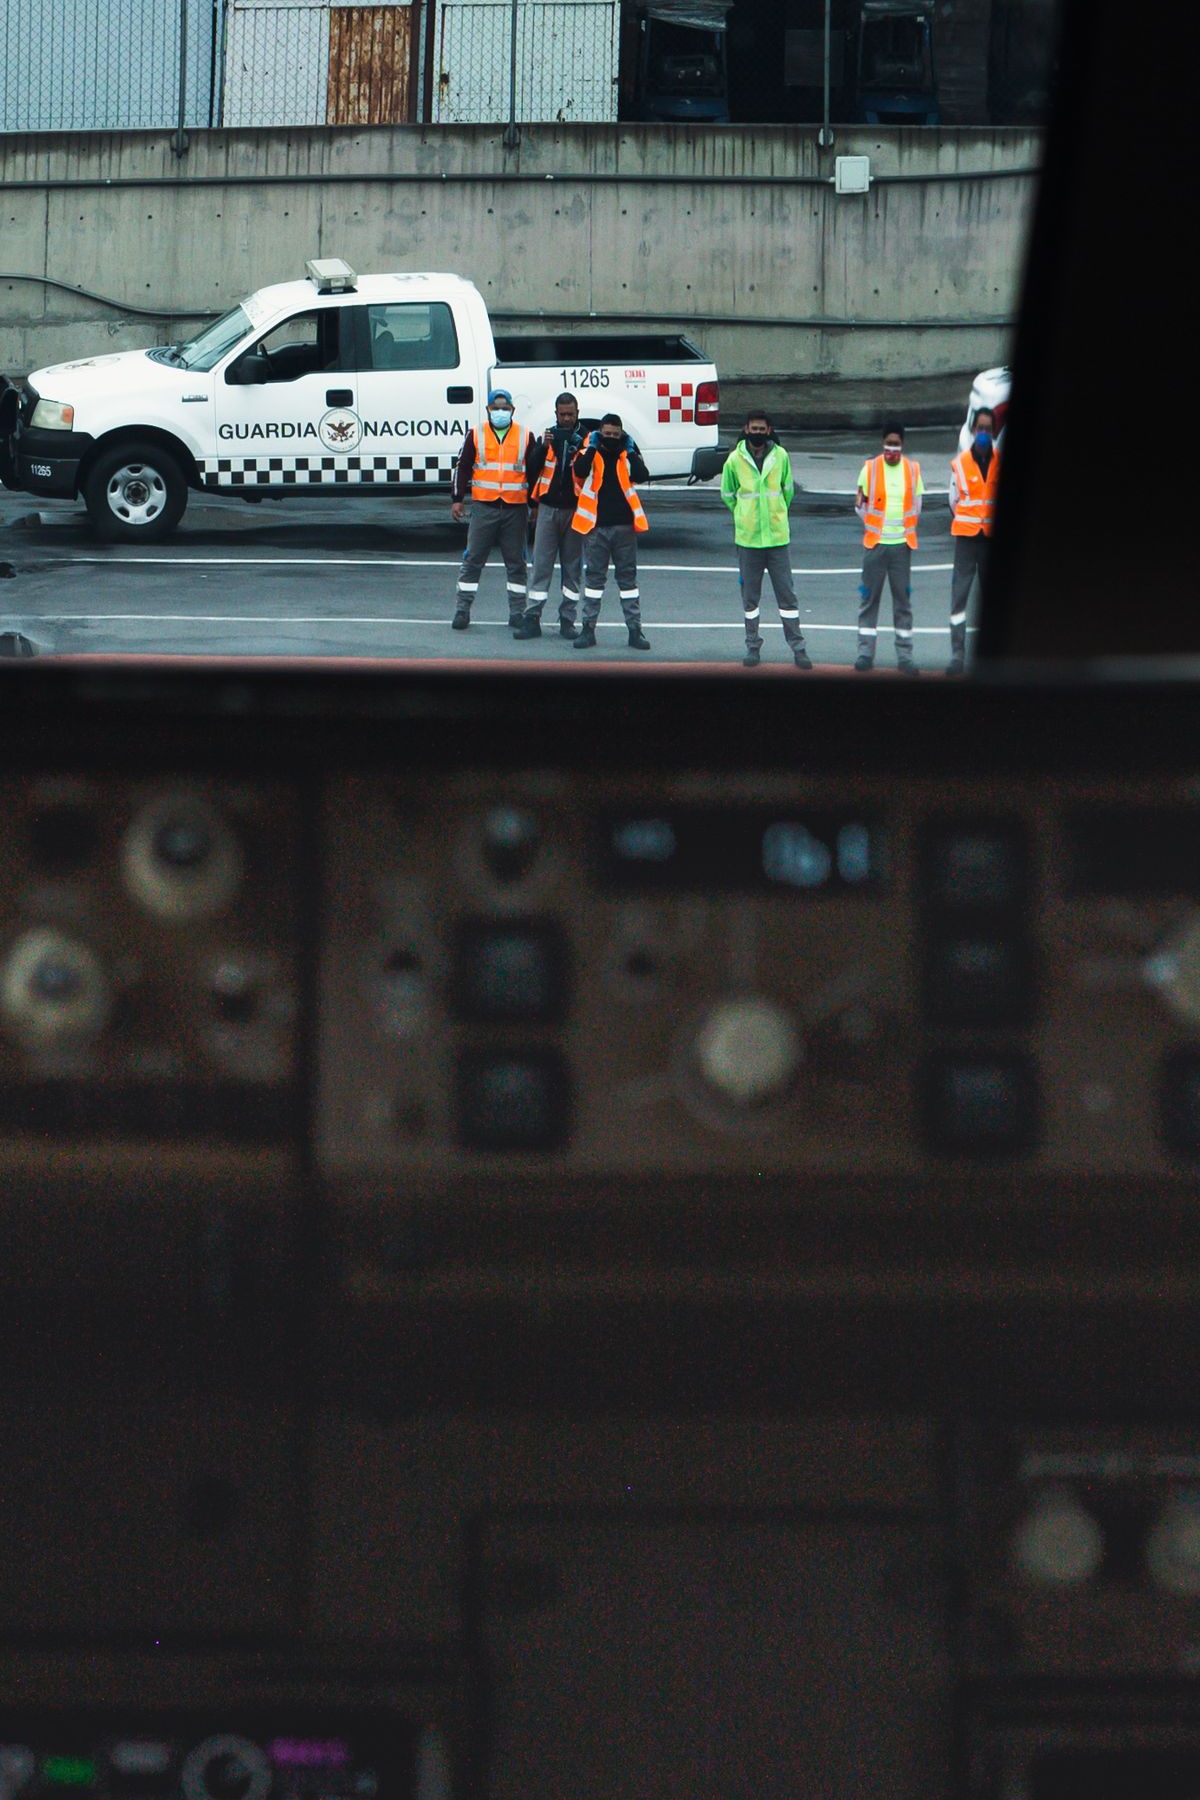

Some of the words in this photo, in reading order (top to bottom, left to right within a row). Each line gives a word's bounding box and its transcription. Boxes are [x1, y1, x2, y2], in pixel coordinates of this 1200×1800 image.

[560, 368, 610, 389] 11265
[218, 422, 318, 439] GUARDIA
[31, 464, 52, 477] 11265
